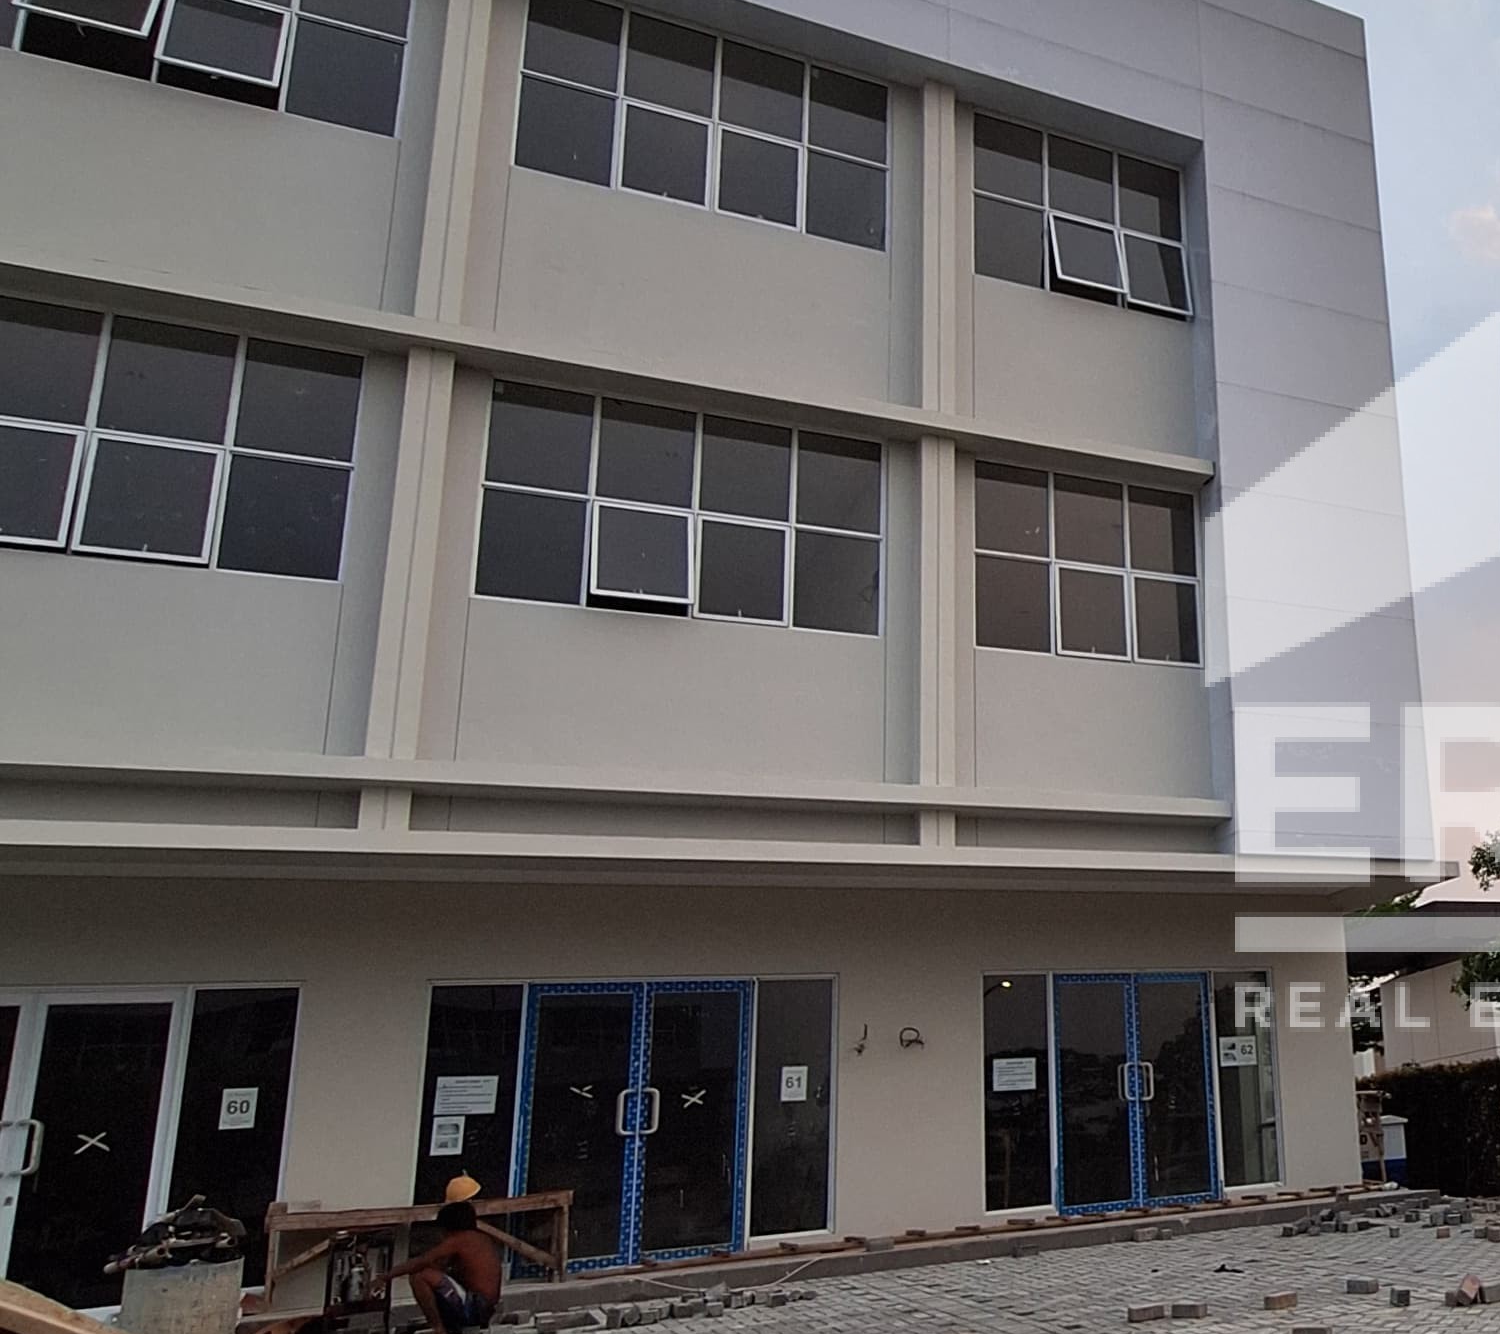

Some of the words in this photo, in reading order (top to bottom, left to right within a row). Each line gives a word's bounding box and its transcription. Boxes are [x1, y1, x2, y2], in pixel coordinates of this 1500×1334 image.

[1240, 1044, 1254, 1056] 62
[785, 1076, 802, 1089] 61
[227, 1099, 250, 1115] 60
